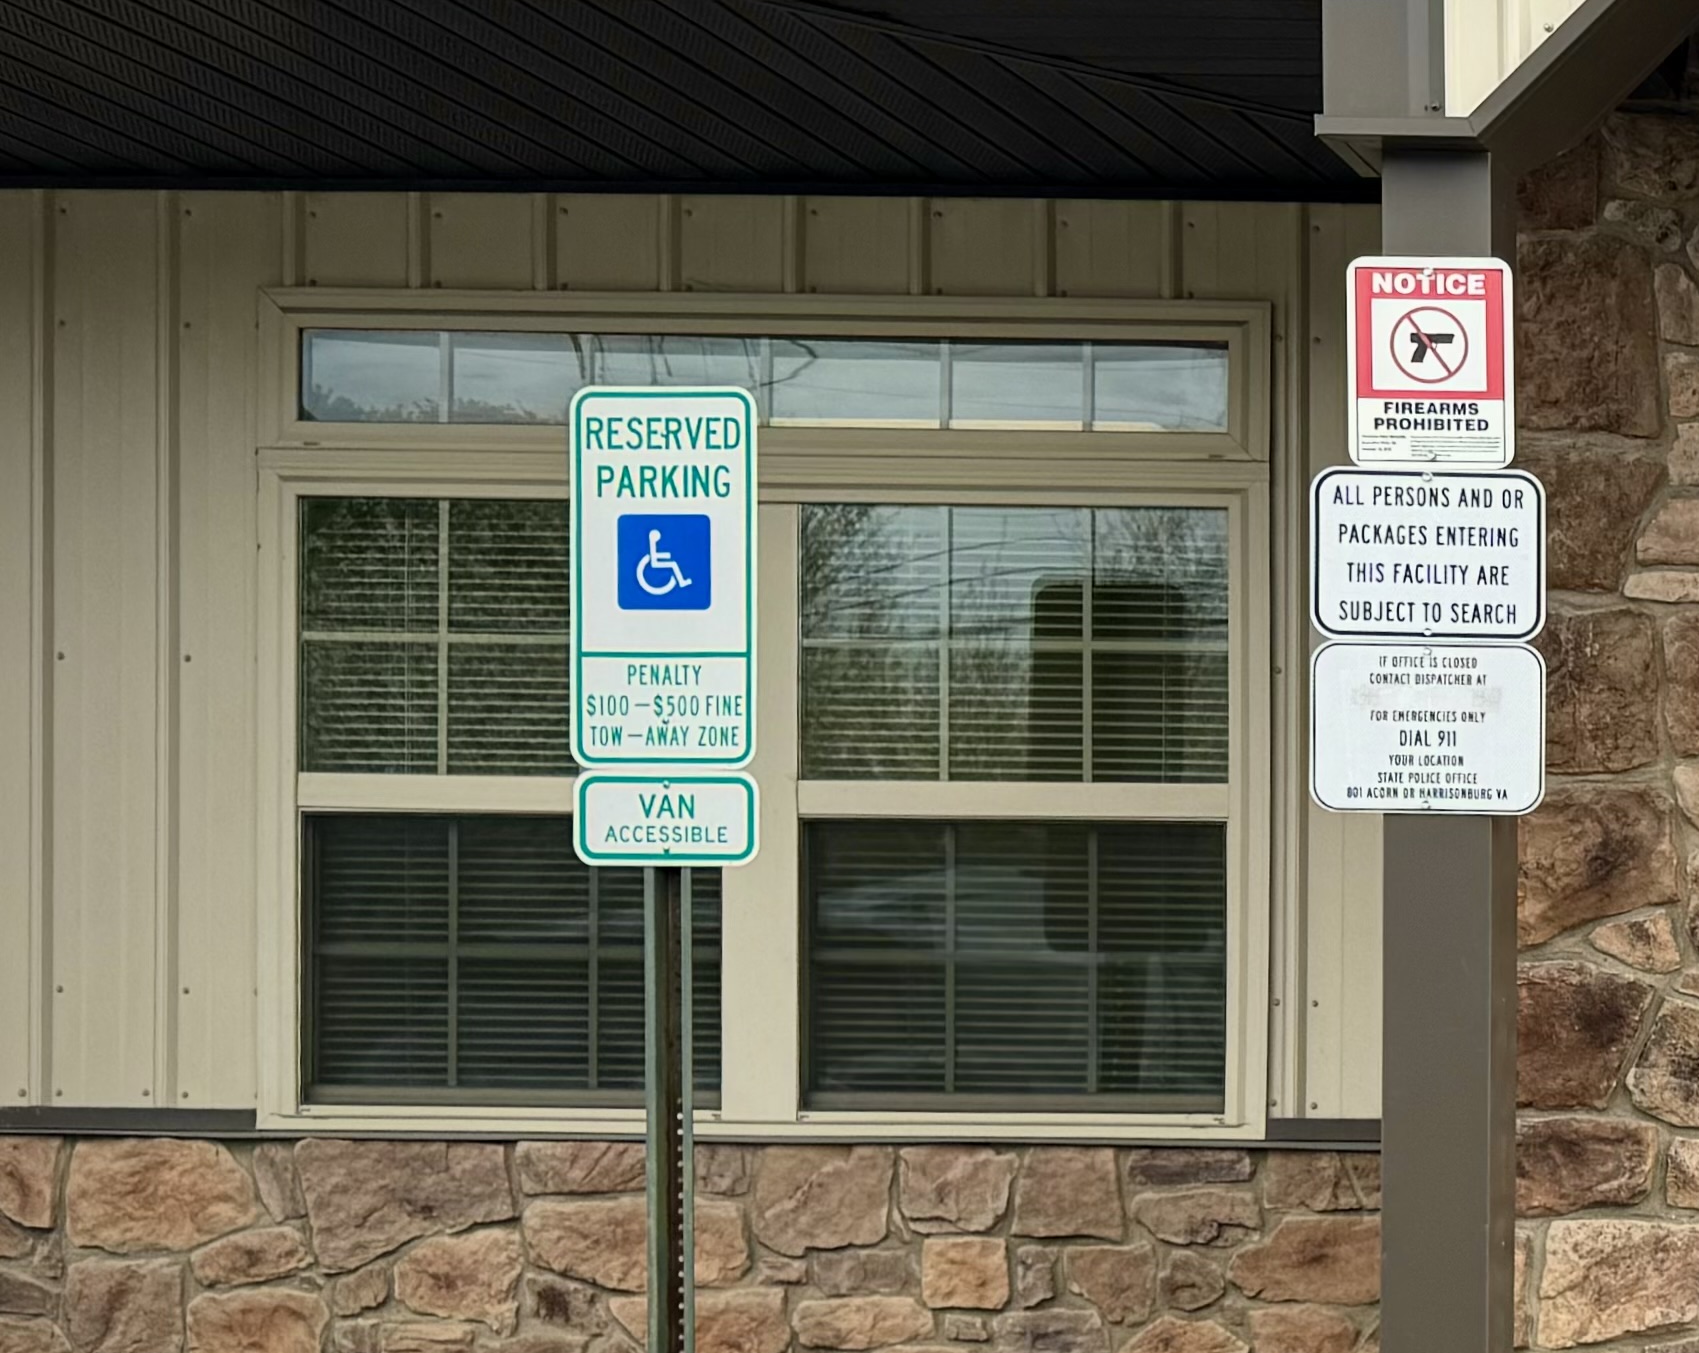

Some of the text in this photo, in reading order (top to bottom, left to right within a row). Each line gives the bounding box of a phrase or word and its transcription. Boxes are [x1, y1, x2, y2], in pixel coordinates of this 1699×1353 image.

[1372, 272, 1486, 295] NOTICE
[1383, 402, 1479, 415] FIREARMS
[585, 416, 741, 450] RESERVED
[1374, 418, 1489, 431] PROHIBITED
[596, 465, 731, 498] PARKING
[1333, 485, 1524, 509] ALL PERSONS AND OR
[1339, 524, 1519, 548] PACKAGES ENTERING
[1347, 562, 1510, 586] THIS FACILITY ARE
[1339, 600, 1517, 624] SUBJECT TO SEARCH
[1379, 656, 1478, 669] IF OFFICE IS CLOSED
[627, 664, 703, 686] PENALTY
[1370, 673, 1487, 686] CONTACT DISPATCHER AT
[705, 696, 742, 717] FINE
[1370, 711, 1486, 723] FOR EMERGENCIES ONLY
[698, 726, 739, 747] ZONE
[1400, 730, 1457, 747] DIAL 911
[1389, 755, 1464, 767] YOUR LOCATION
[1378, 772, 1478, 785] STATE POLICE OFFICE
[1347, 787, 1363, 798] 801
[1367, 787, 1399, 799] ACORN
[1419, 788, 1492, 800] HARRISONBURG
[1496, 789, 1508, 800] VA
[639, 793, 695, 819] VAN
[605, 826, 727, 843] ACCESSIBLE
